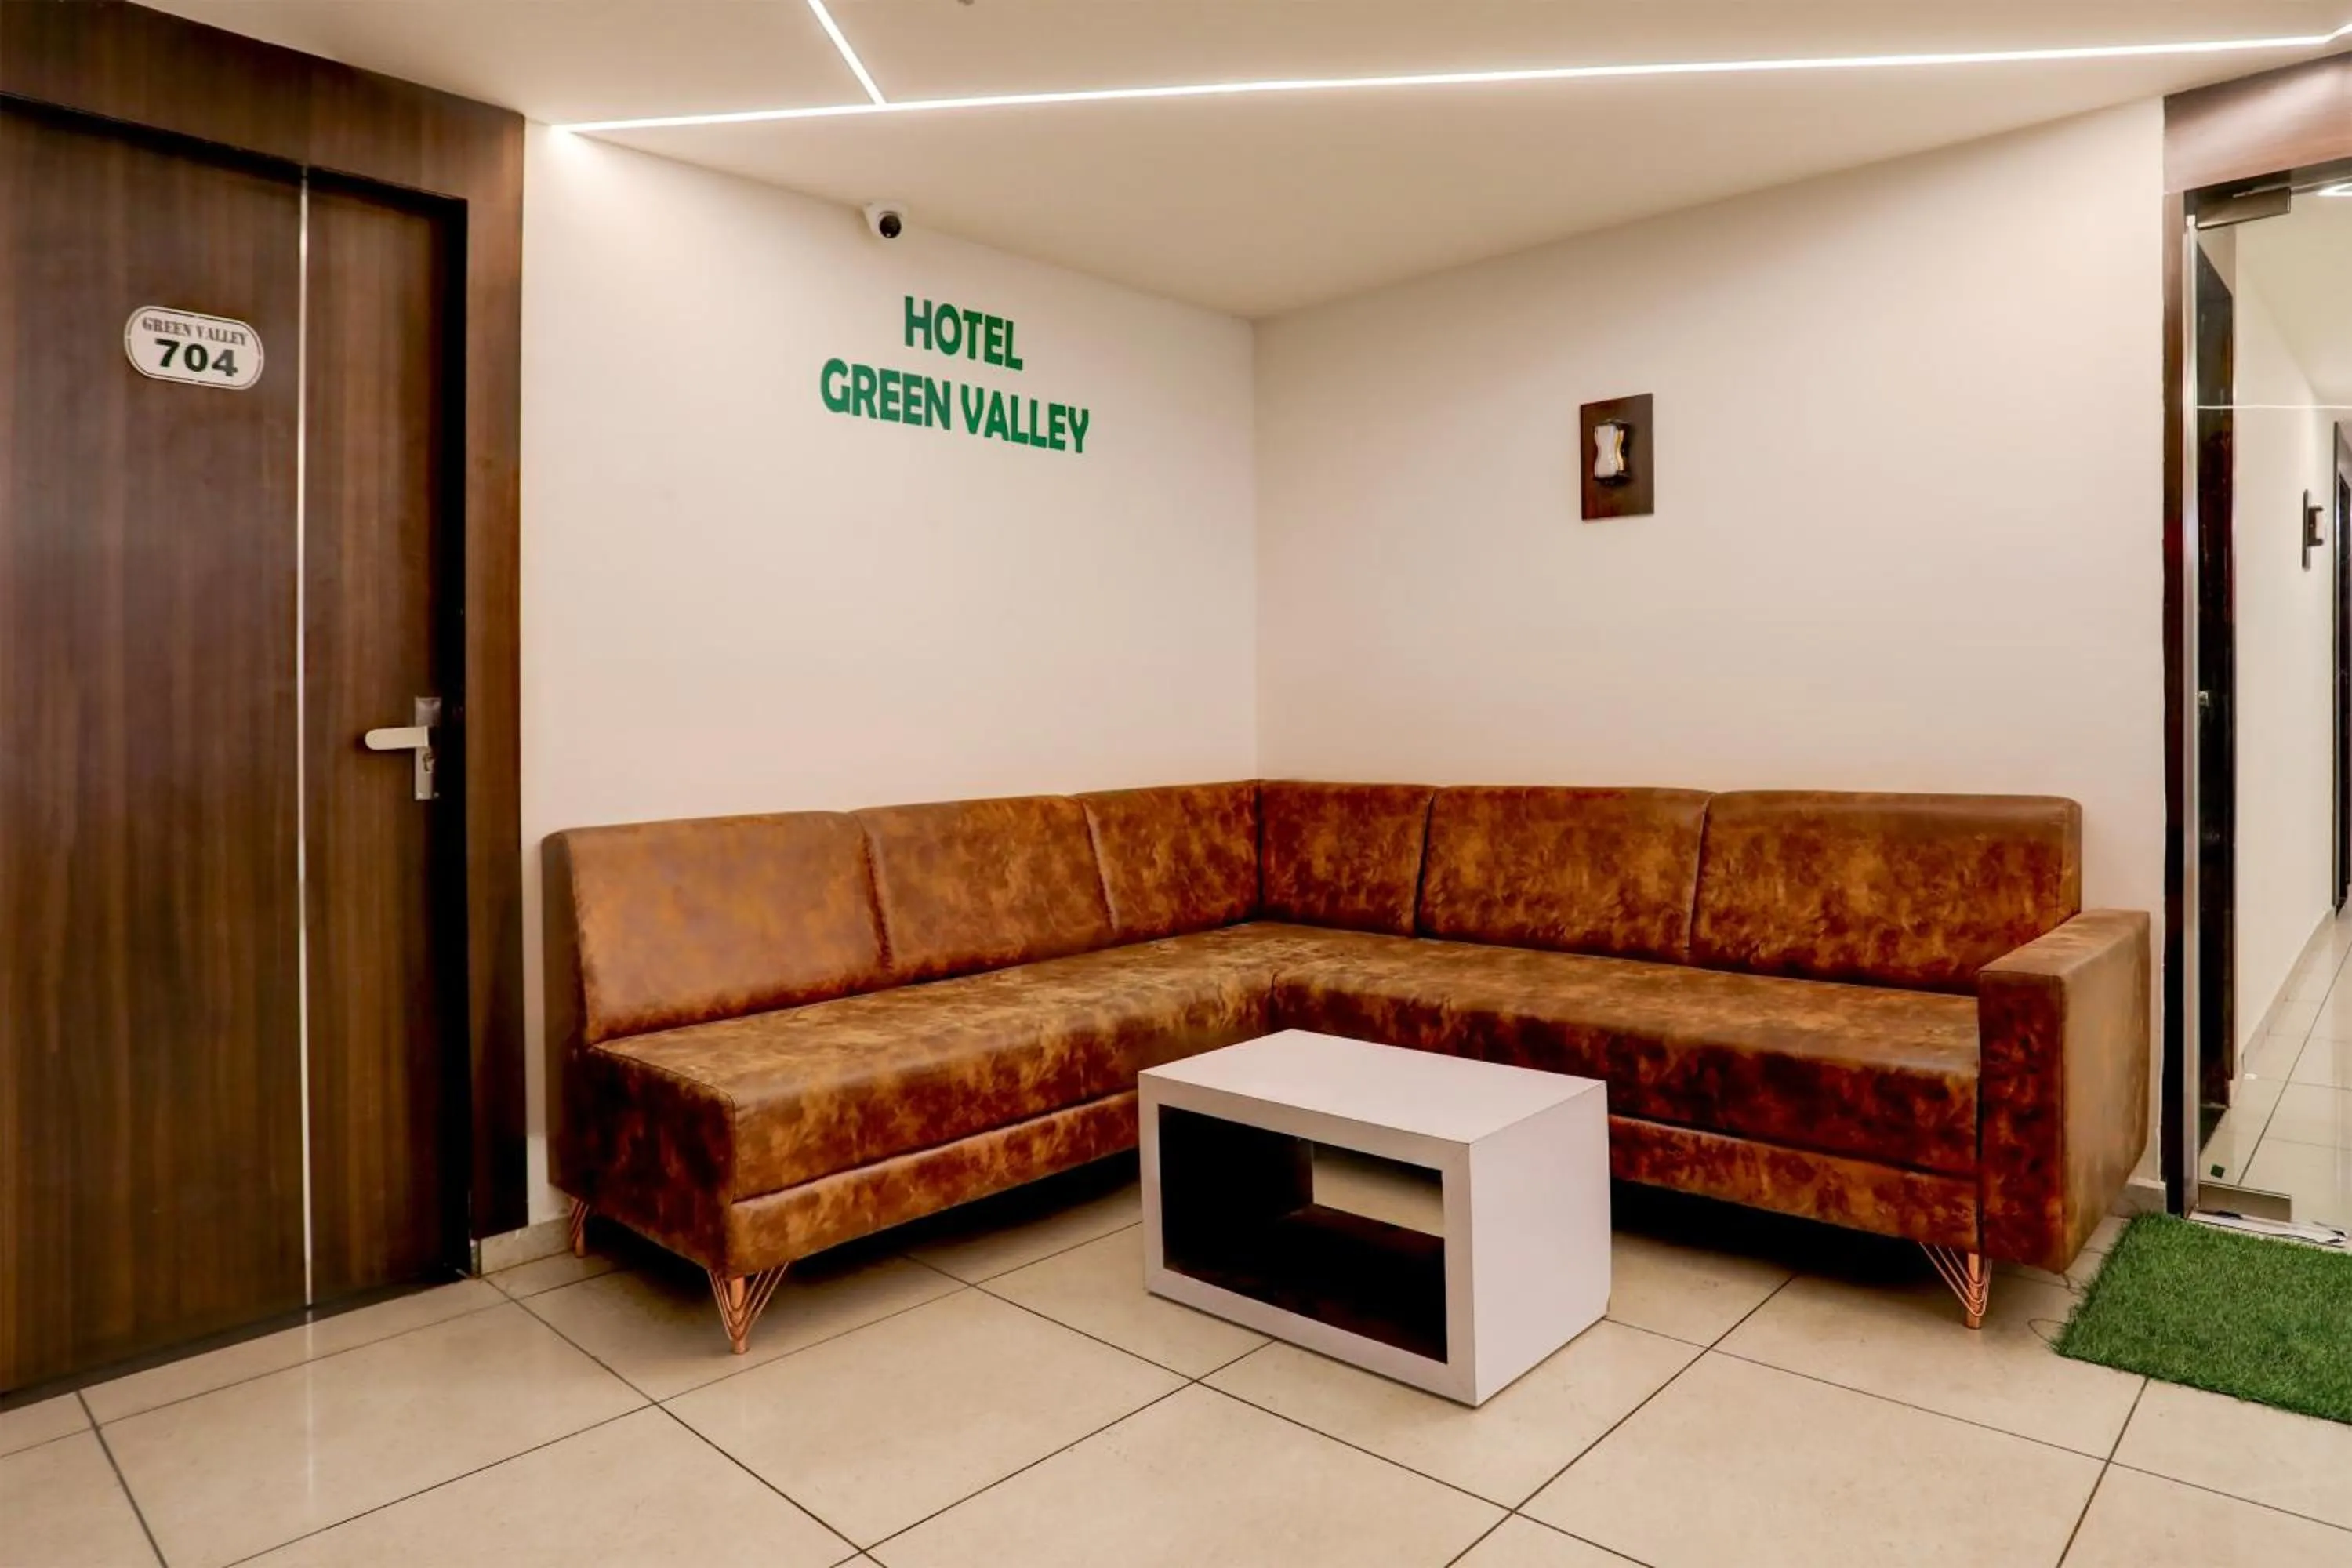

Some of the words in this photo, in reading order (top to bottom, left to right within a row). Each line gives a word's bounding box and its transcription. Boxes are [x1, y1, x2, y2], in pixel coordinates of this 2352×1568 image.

[142, 316, 192, 337] GREEN
[195, 325, 248, 346] VALLEY
[154, 337, 238, 377] 704
[904, 295, 1023, 371] HOTEL
[820, 358, 951, 430] GREEN
[960, 383, 1089, 453] VALLEY
